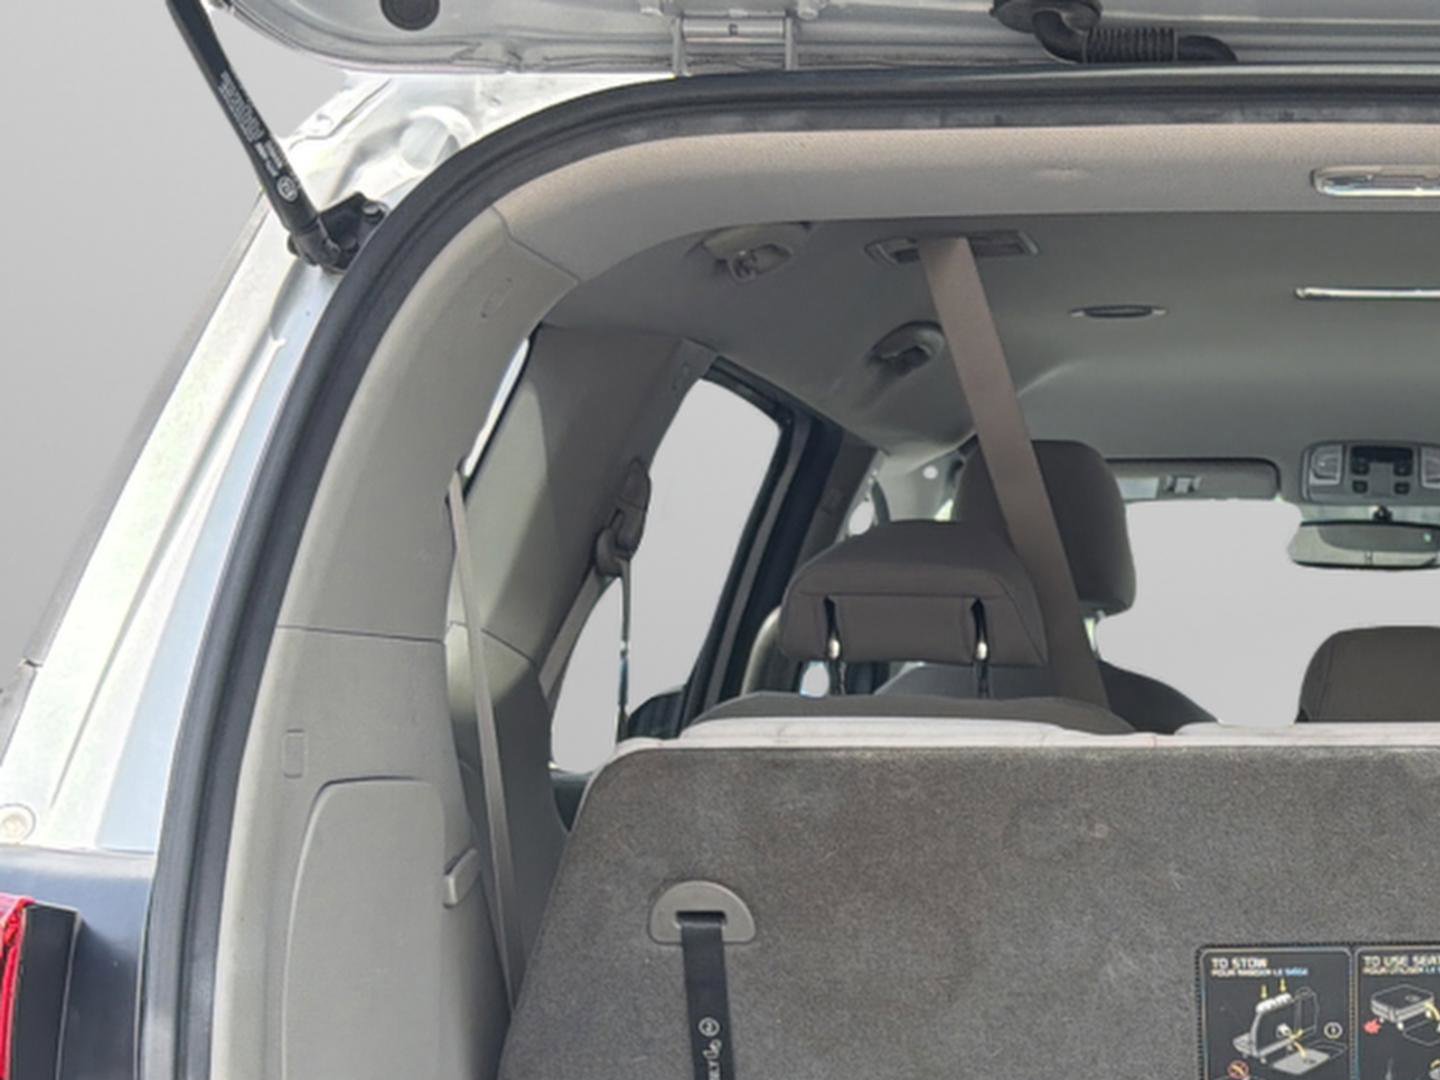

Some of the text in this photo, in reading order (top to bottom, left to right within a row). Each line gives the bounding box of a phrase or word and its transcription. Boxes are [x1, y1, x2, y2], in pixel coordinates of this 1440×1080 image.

[1211, 957, 1268, 969] TO STOW
[1363, 955, 1380, 967] TO
[1383, 955, 1408, 967] USE
